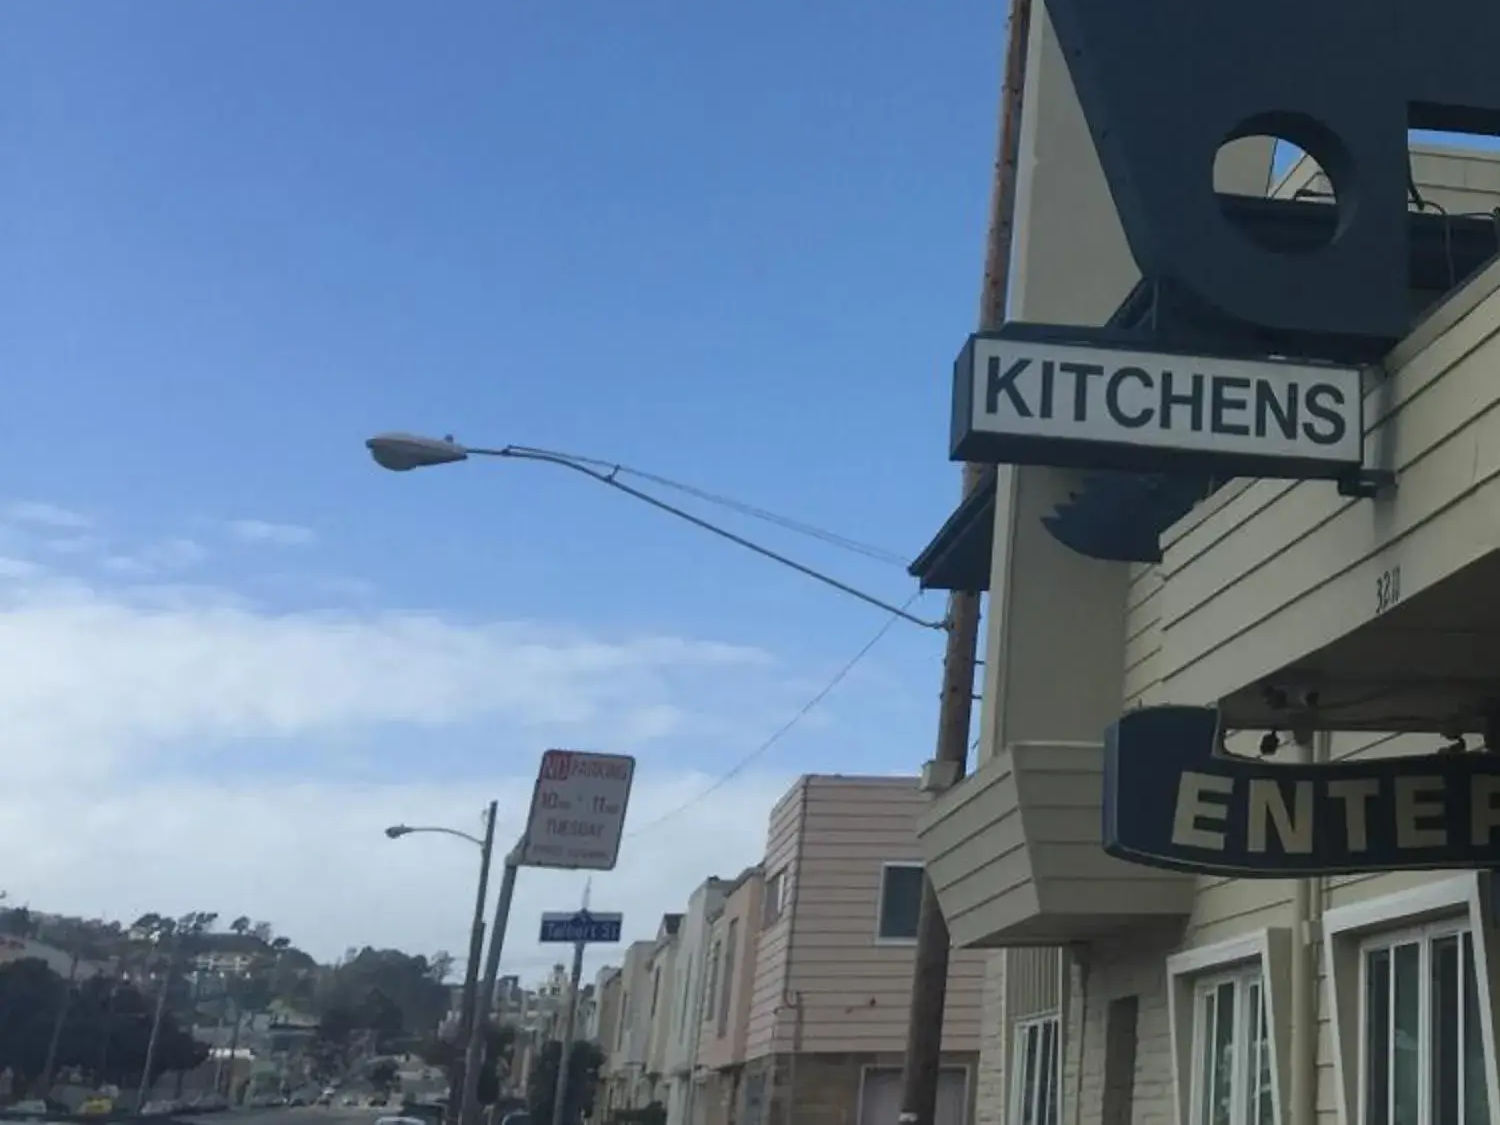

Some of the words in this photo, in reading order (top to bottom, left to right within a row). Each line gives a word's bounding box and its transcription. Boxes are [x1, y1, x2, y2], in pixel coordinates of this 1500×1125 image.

[985, 355, 1346, 445] KITCHENS
[543, 753, 569, 779] NO
[570, 757, 627, 780] PARKING
[546, 818, 607, 838] TUESDAY
